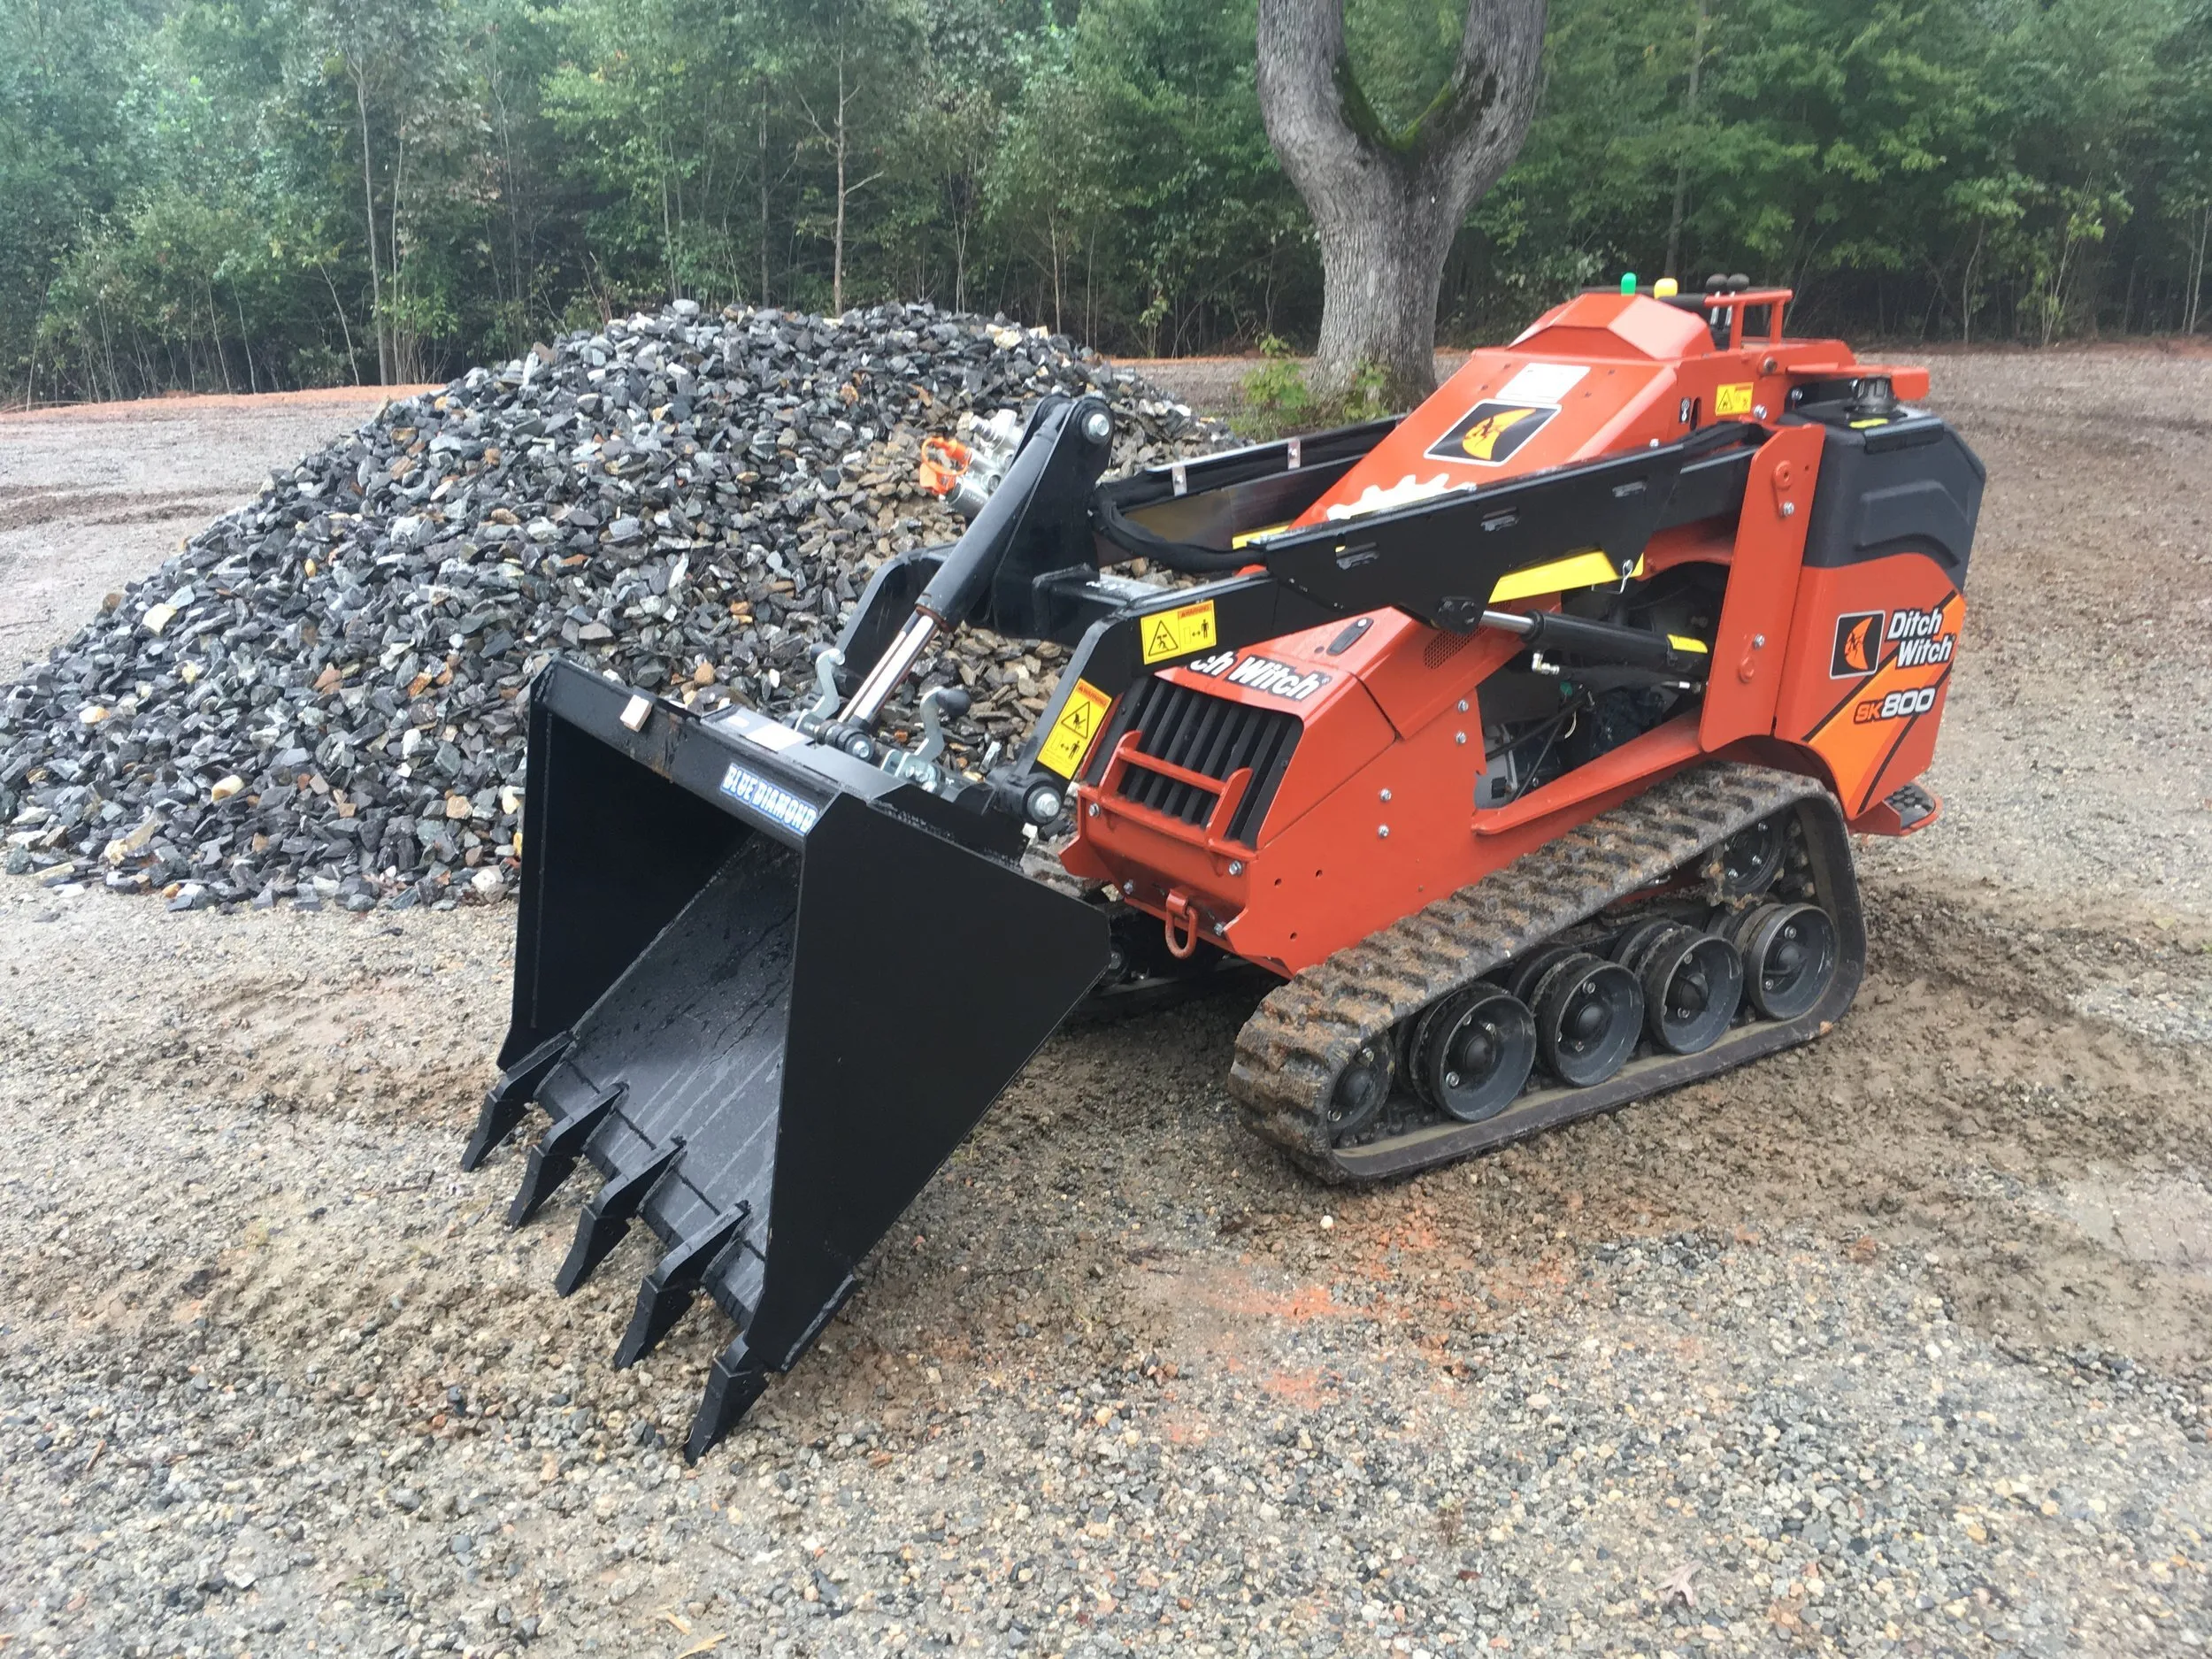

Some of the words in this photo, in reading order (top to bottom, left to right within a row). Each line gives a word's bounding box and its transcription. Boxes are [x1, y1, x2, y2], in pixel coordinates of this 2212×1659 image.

[1886, 608, 1943, 640] Ditch
[1897, 635, 1954, 667] Witch
[1227, 656, 1320, 699] Witch
[1855, 687, 1936, 723] SK800
[722, 764, 759, 801] BLUE
[751, 781, 817, 833] DIAMOND
